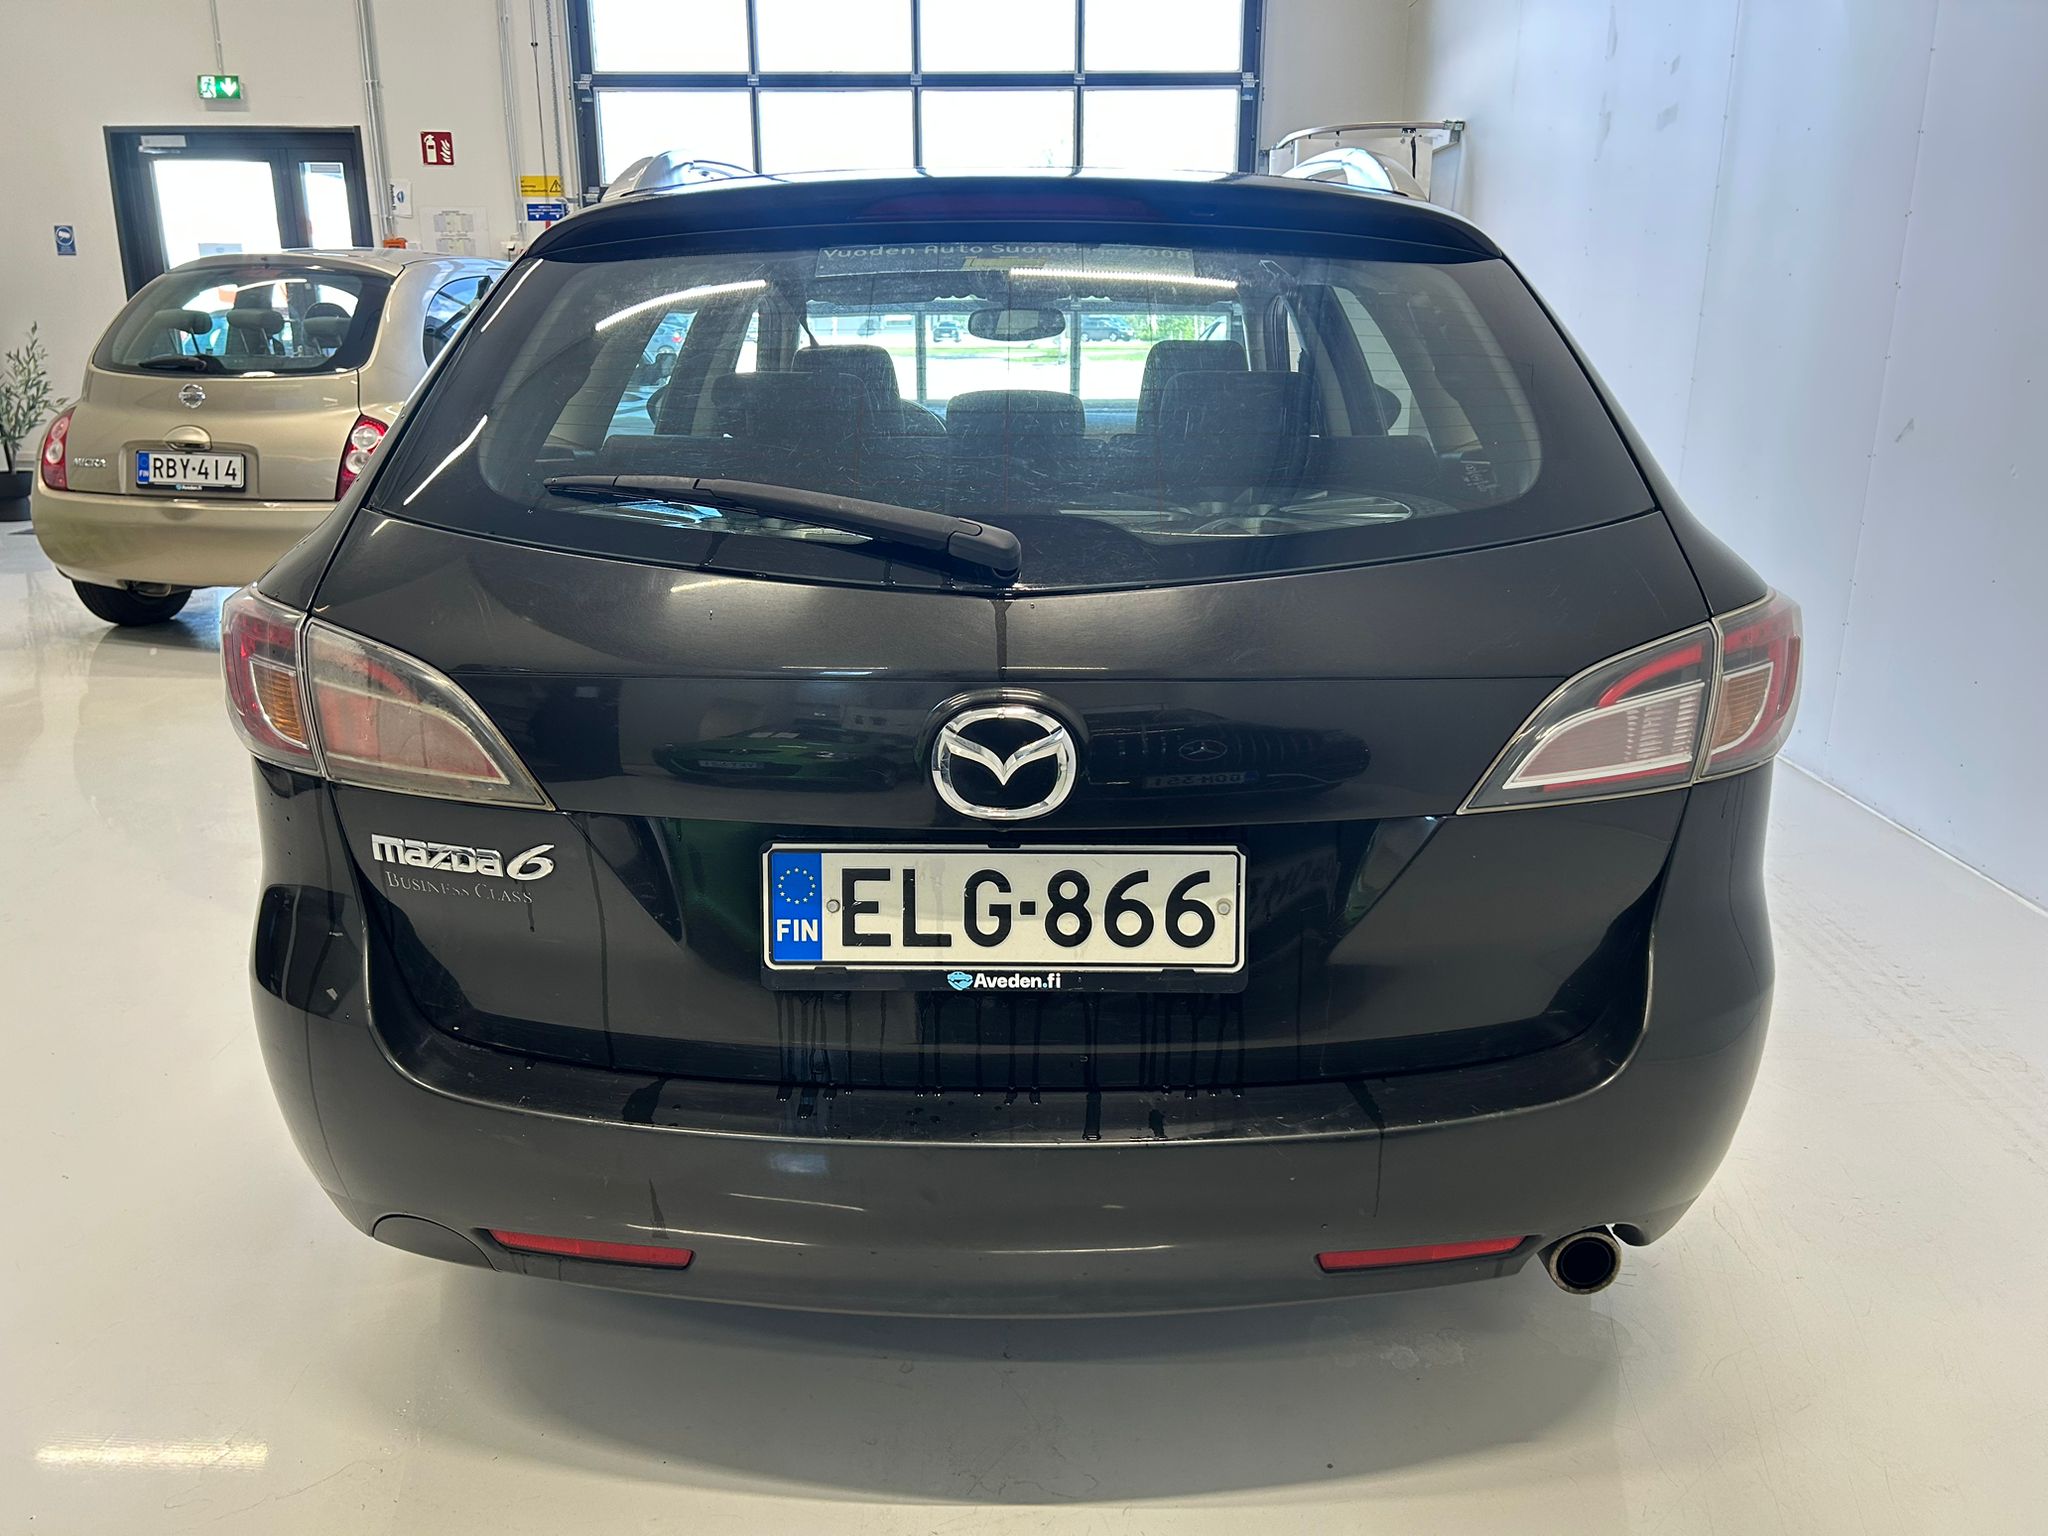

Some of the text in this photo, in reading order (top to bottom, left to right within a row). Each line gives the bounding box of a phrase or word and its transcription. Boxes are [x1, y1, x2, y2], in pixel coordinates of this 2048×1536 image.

[824, 246, 915, 258] Vuoden
[924, 245, 983, 254] Auto
[138, 469, 149, 478] FIN
[841, 868, 1216, 949] ELG-866
[776, 919, 819, 942] FIN
[973, 973, 1061, 988] Aveden.fi
